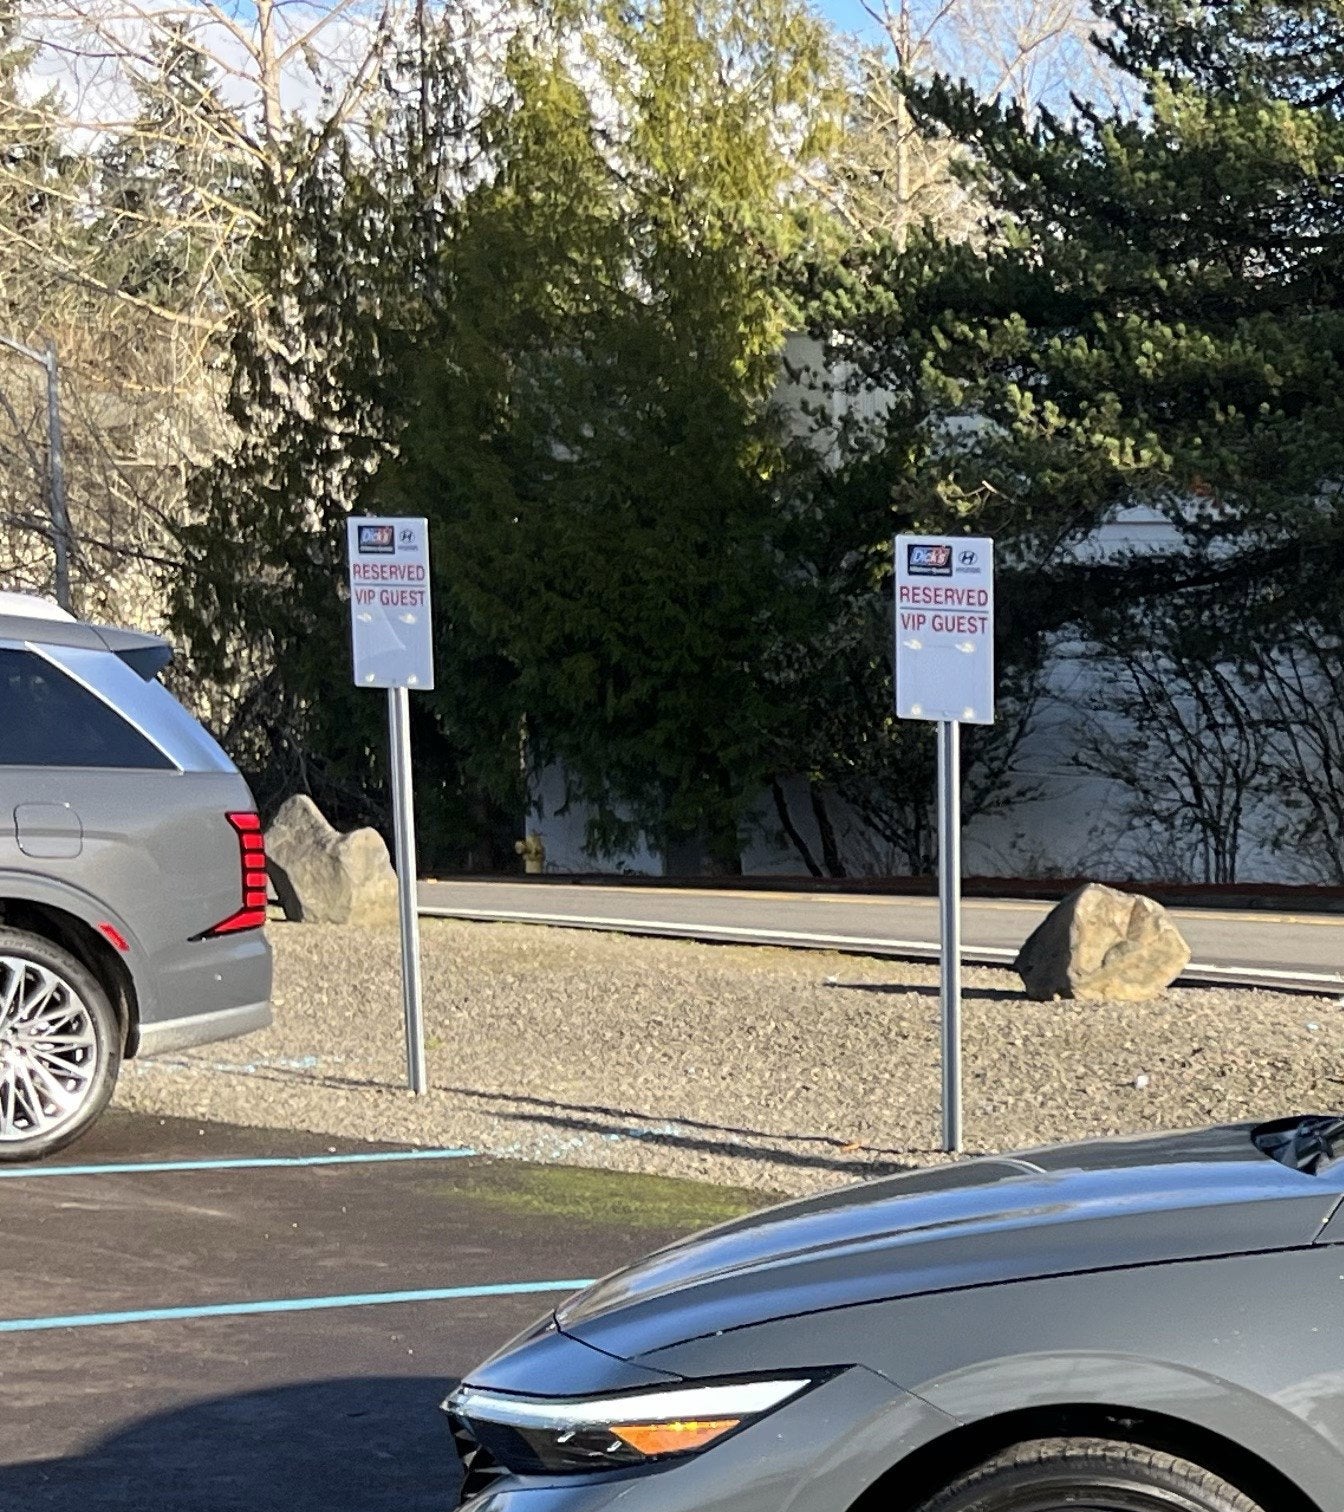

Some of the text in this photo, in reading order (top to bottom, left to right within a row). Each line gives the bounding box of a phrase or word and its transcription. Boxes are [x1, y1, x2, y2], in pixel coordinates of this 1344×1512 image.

[352, 563, 426, 582] RESERVED
[354, 588, 426, 606] VIP GUEST
[900, 585, 989, 607] RESERVED
[901, 613, 988, 635] VIP GUEST
